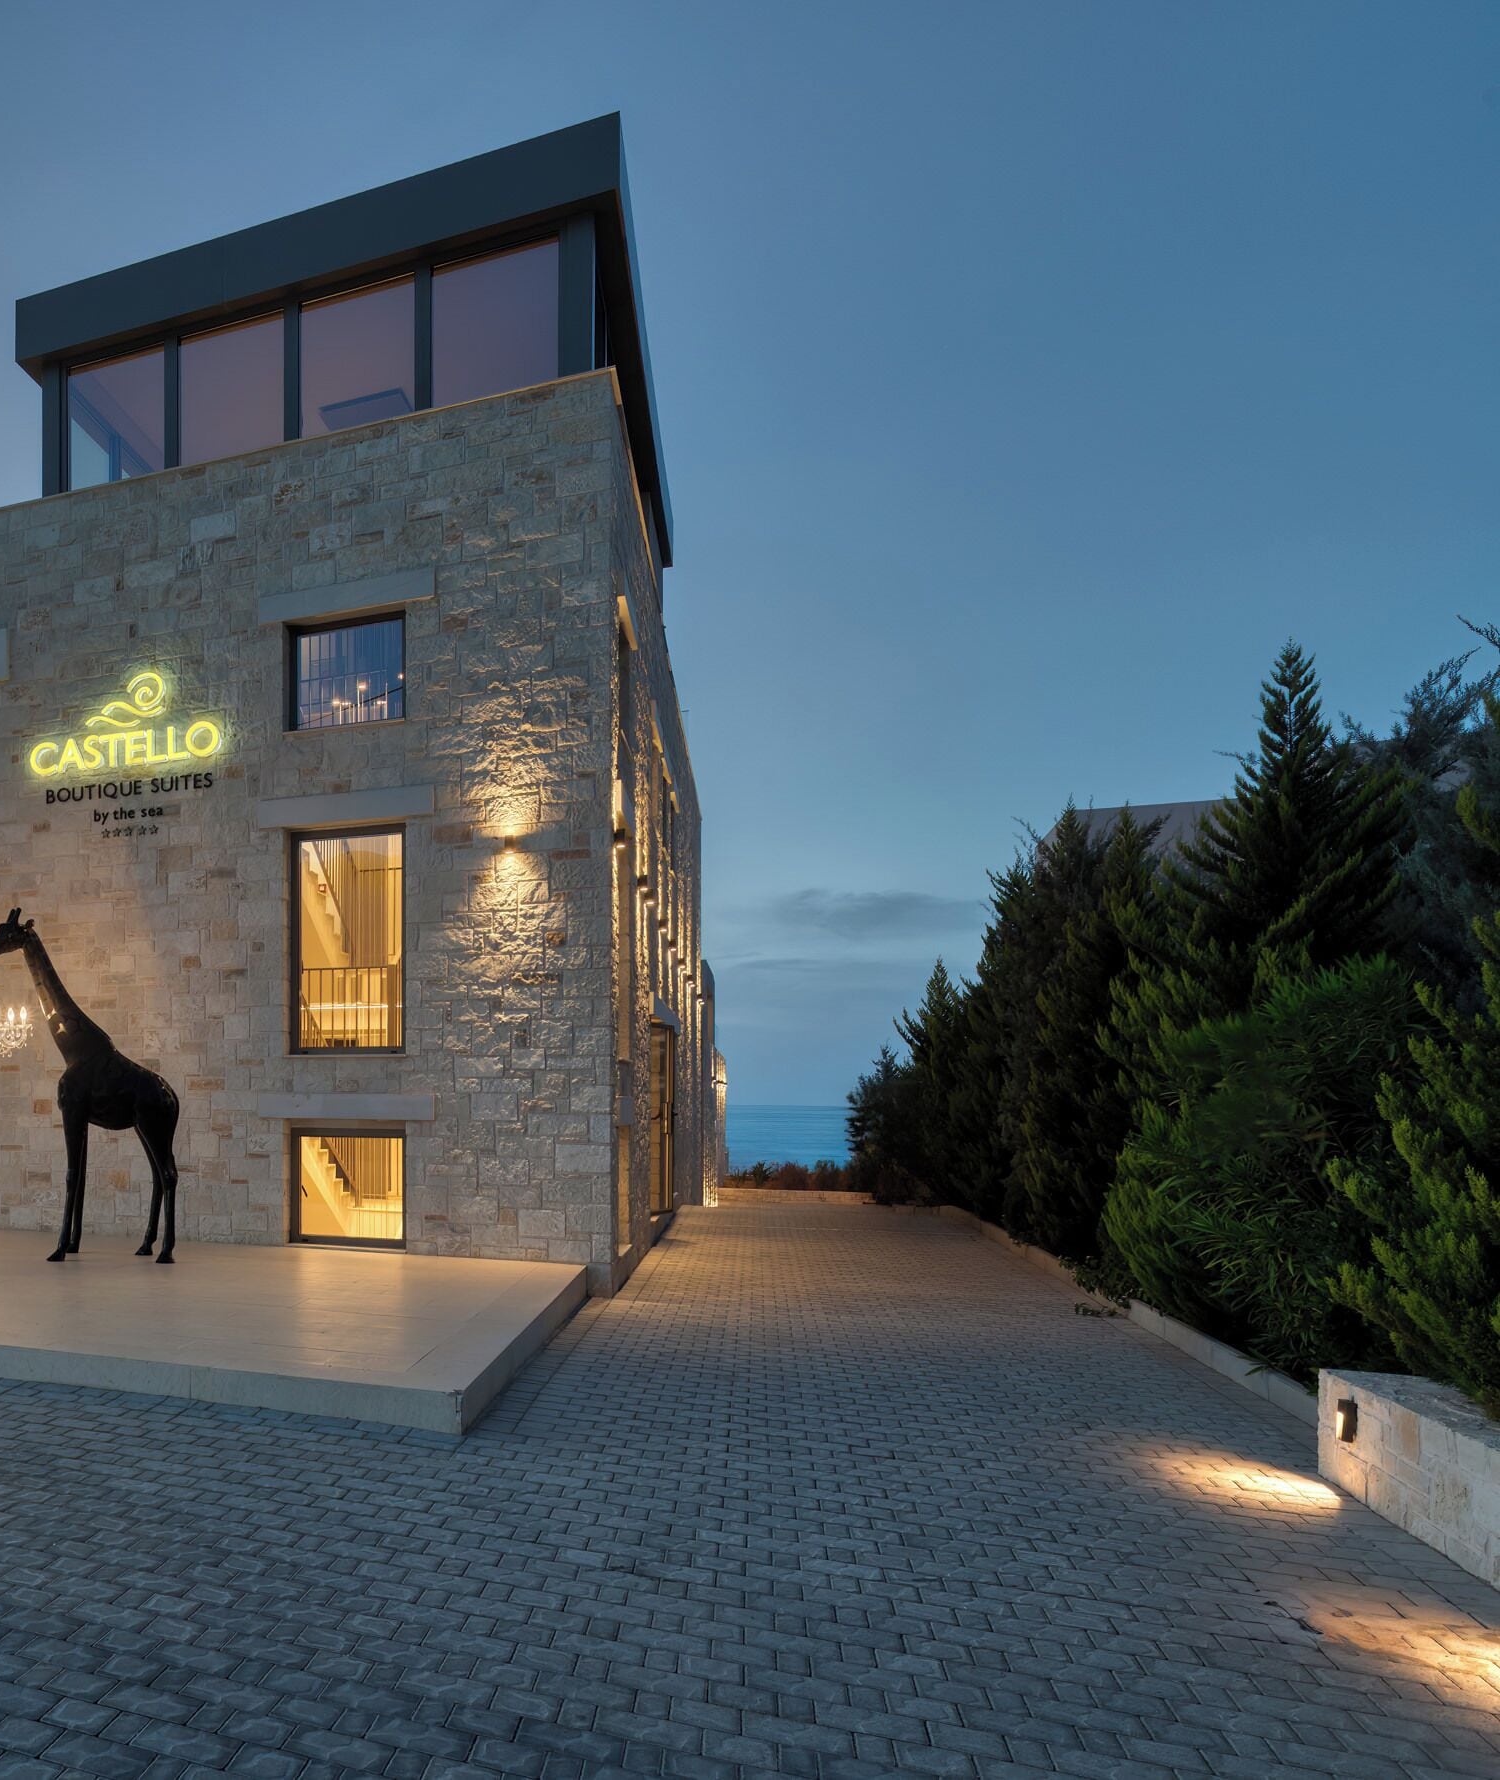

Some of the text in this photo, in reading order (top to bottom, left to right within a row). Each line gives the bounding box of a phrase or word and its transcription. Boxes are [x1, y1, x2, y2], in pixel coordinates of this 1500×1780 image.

[30, 720, 222, 776] CASTELLO
[46, 773, 213, 804] BOUTIQUE SUITES
[93, 806, 164, 825] by the sea
